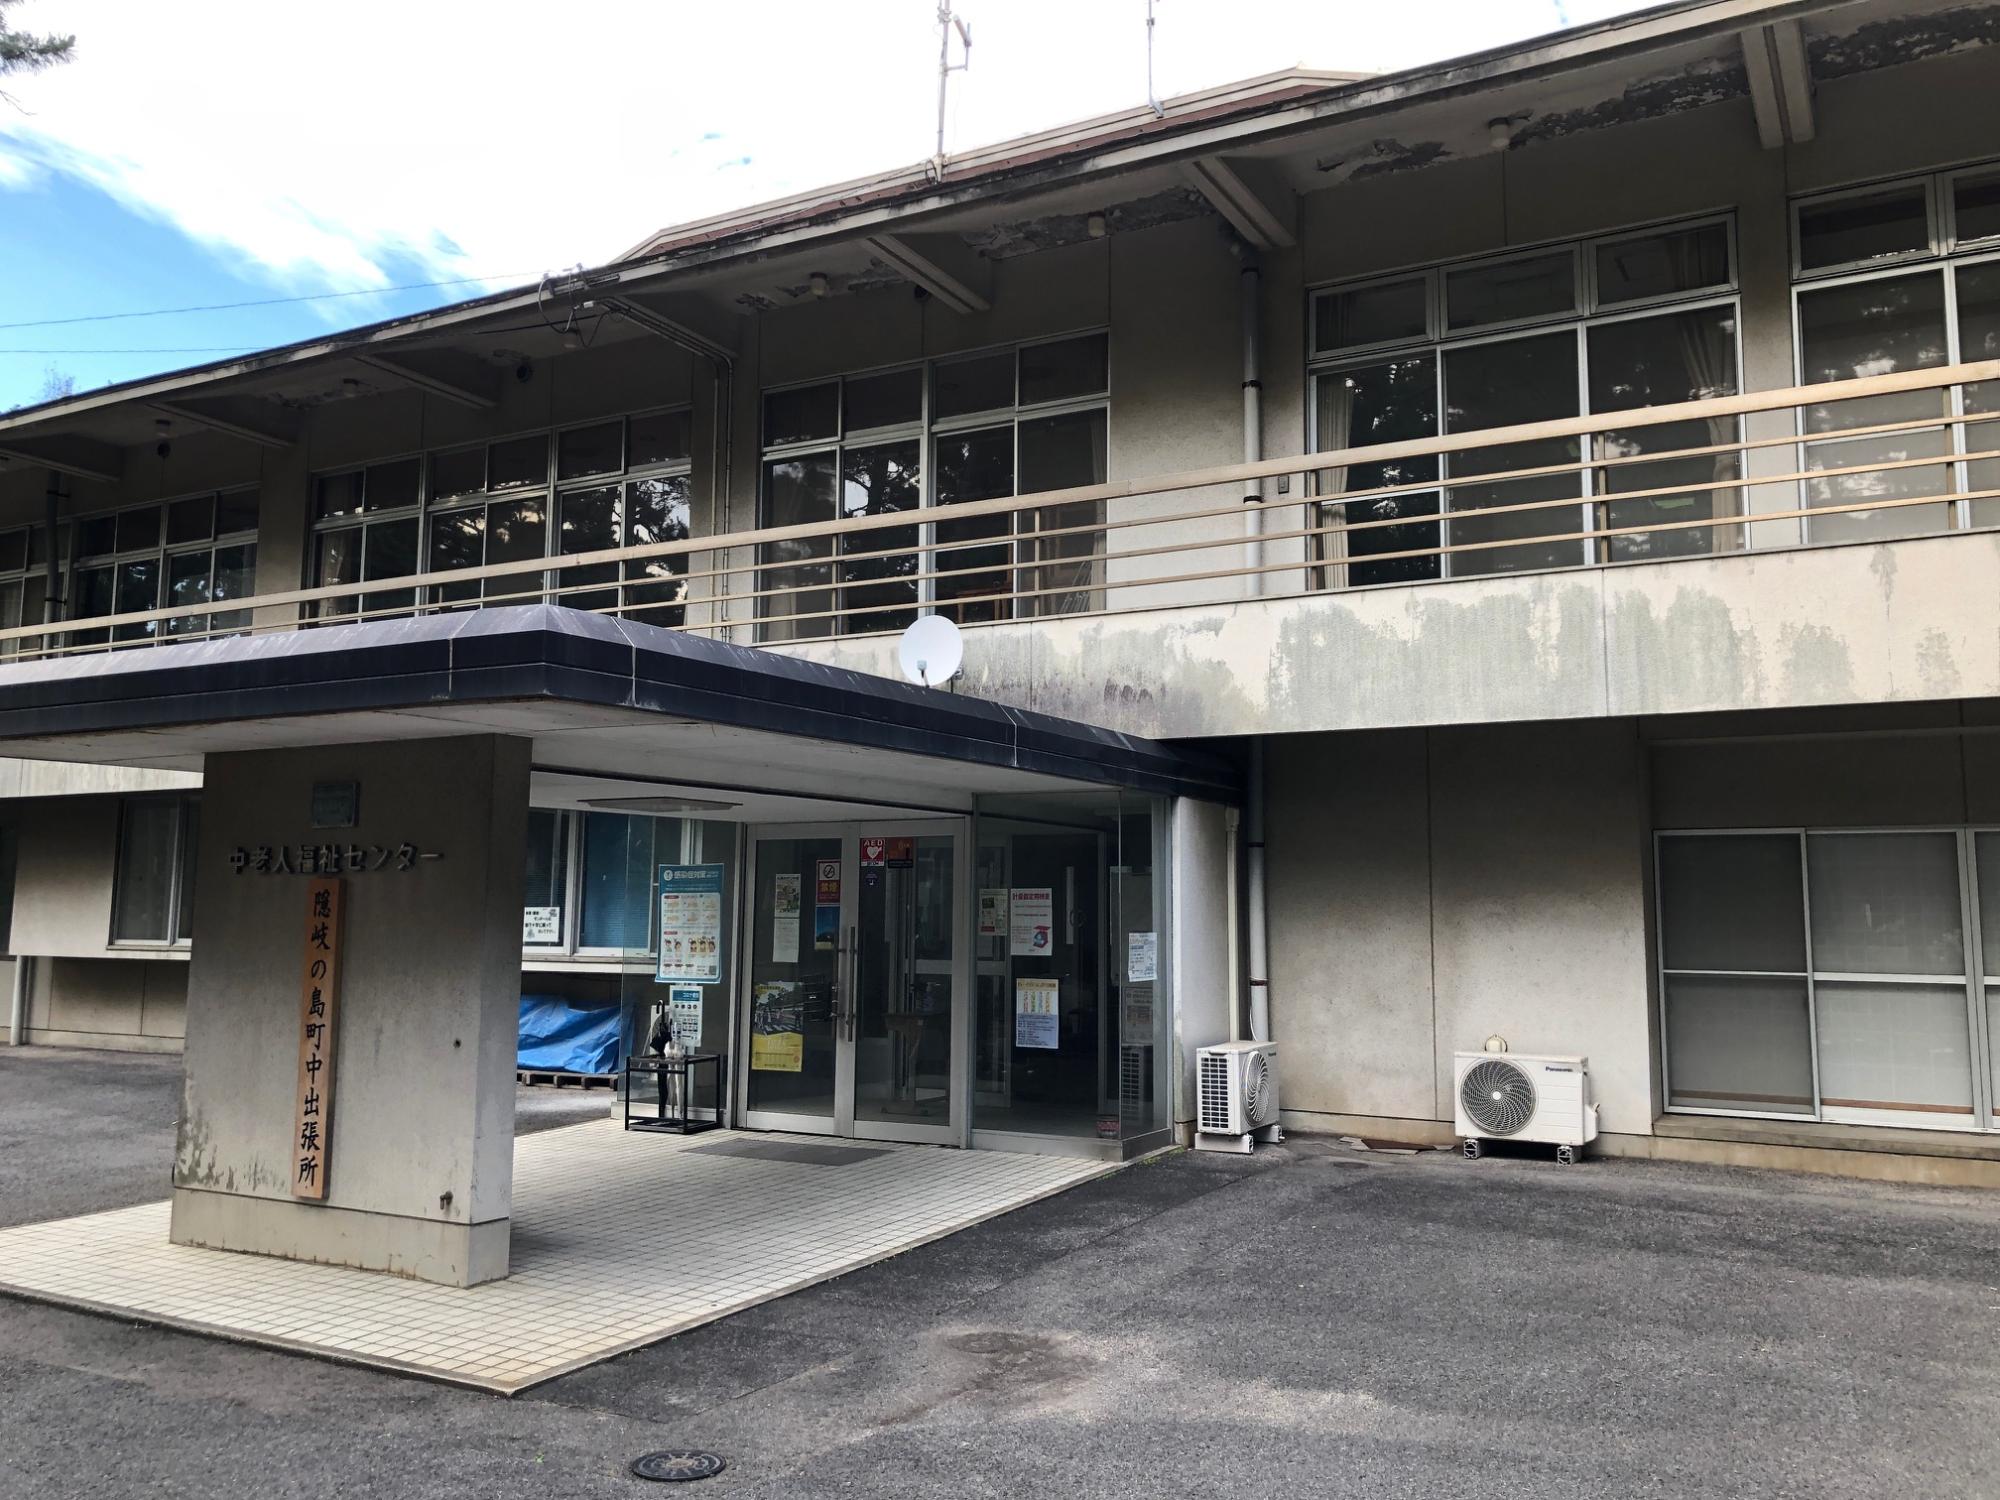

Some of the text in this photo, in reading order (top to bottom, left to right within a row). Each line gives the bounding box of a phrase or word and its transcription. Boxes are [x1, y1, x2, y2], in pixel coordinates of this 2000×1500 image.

[229, 843, 443, 874] 中老人福祉センター
[864, 839, 883, 847] AED
[298, 889, 332, 1187] 隠岐の島町中出張所
